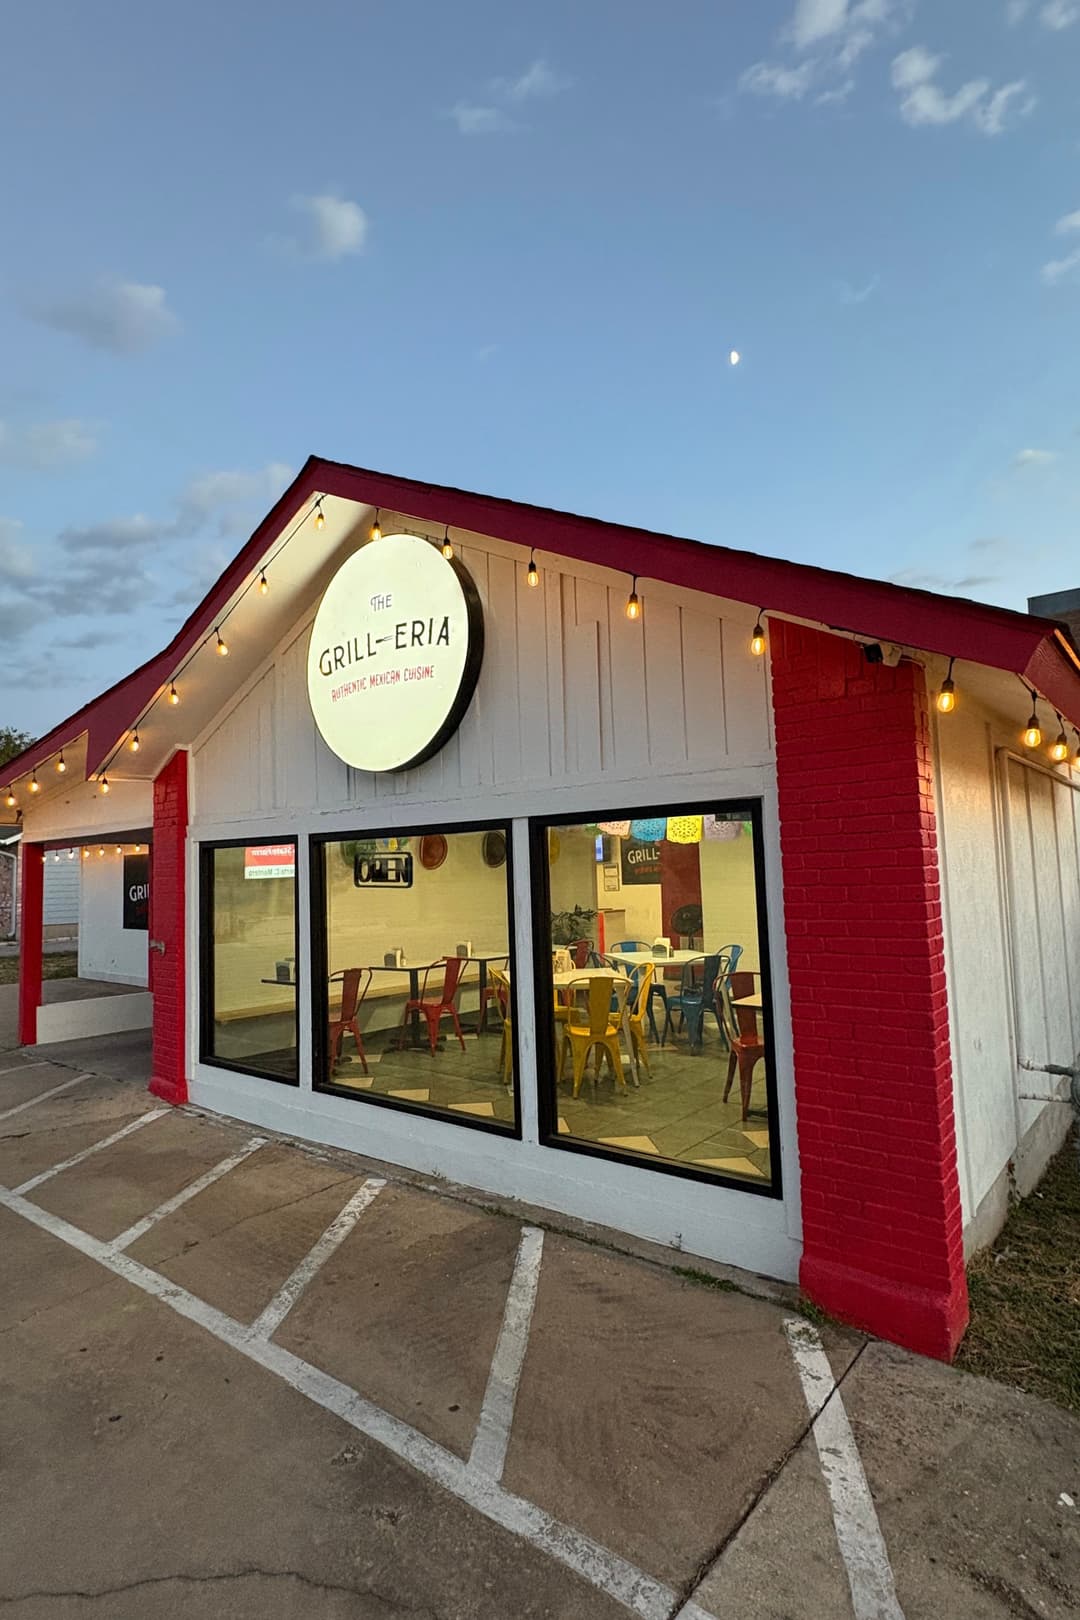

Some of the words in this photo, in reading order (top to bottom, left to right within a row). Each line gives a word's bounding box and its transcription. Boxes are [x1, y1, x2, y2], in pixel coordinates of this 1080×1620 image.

[370, 594, 392, 611] THE
[331, 677, 367, 702] AUTHENTIC
[369, 669, 401, 687] MEXICAN
[403, 665, 435, 682] CUISINE
[358, 857, 409, 882] OPEN
